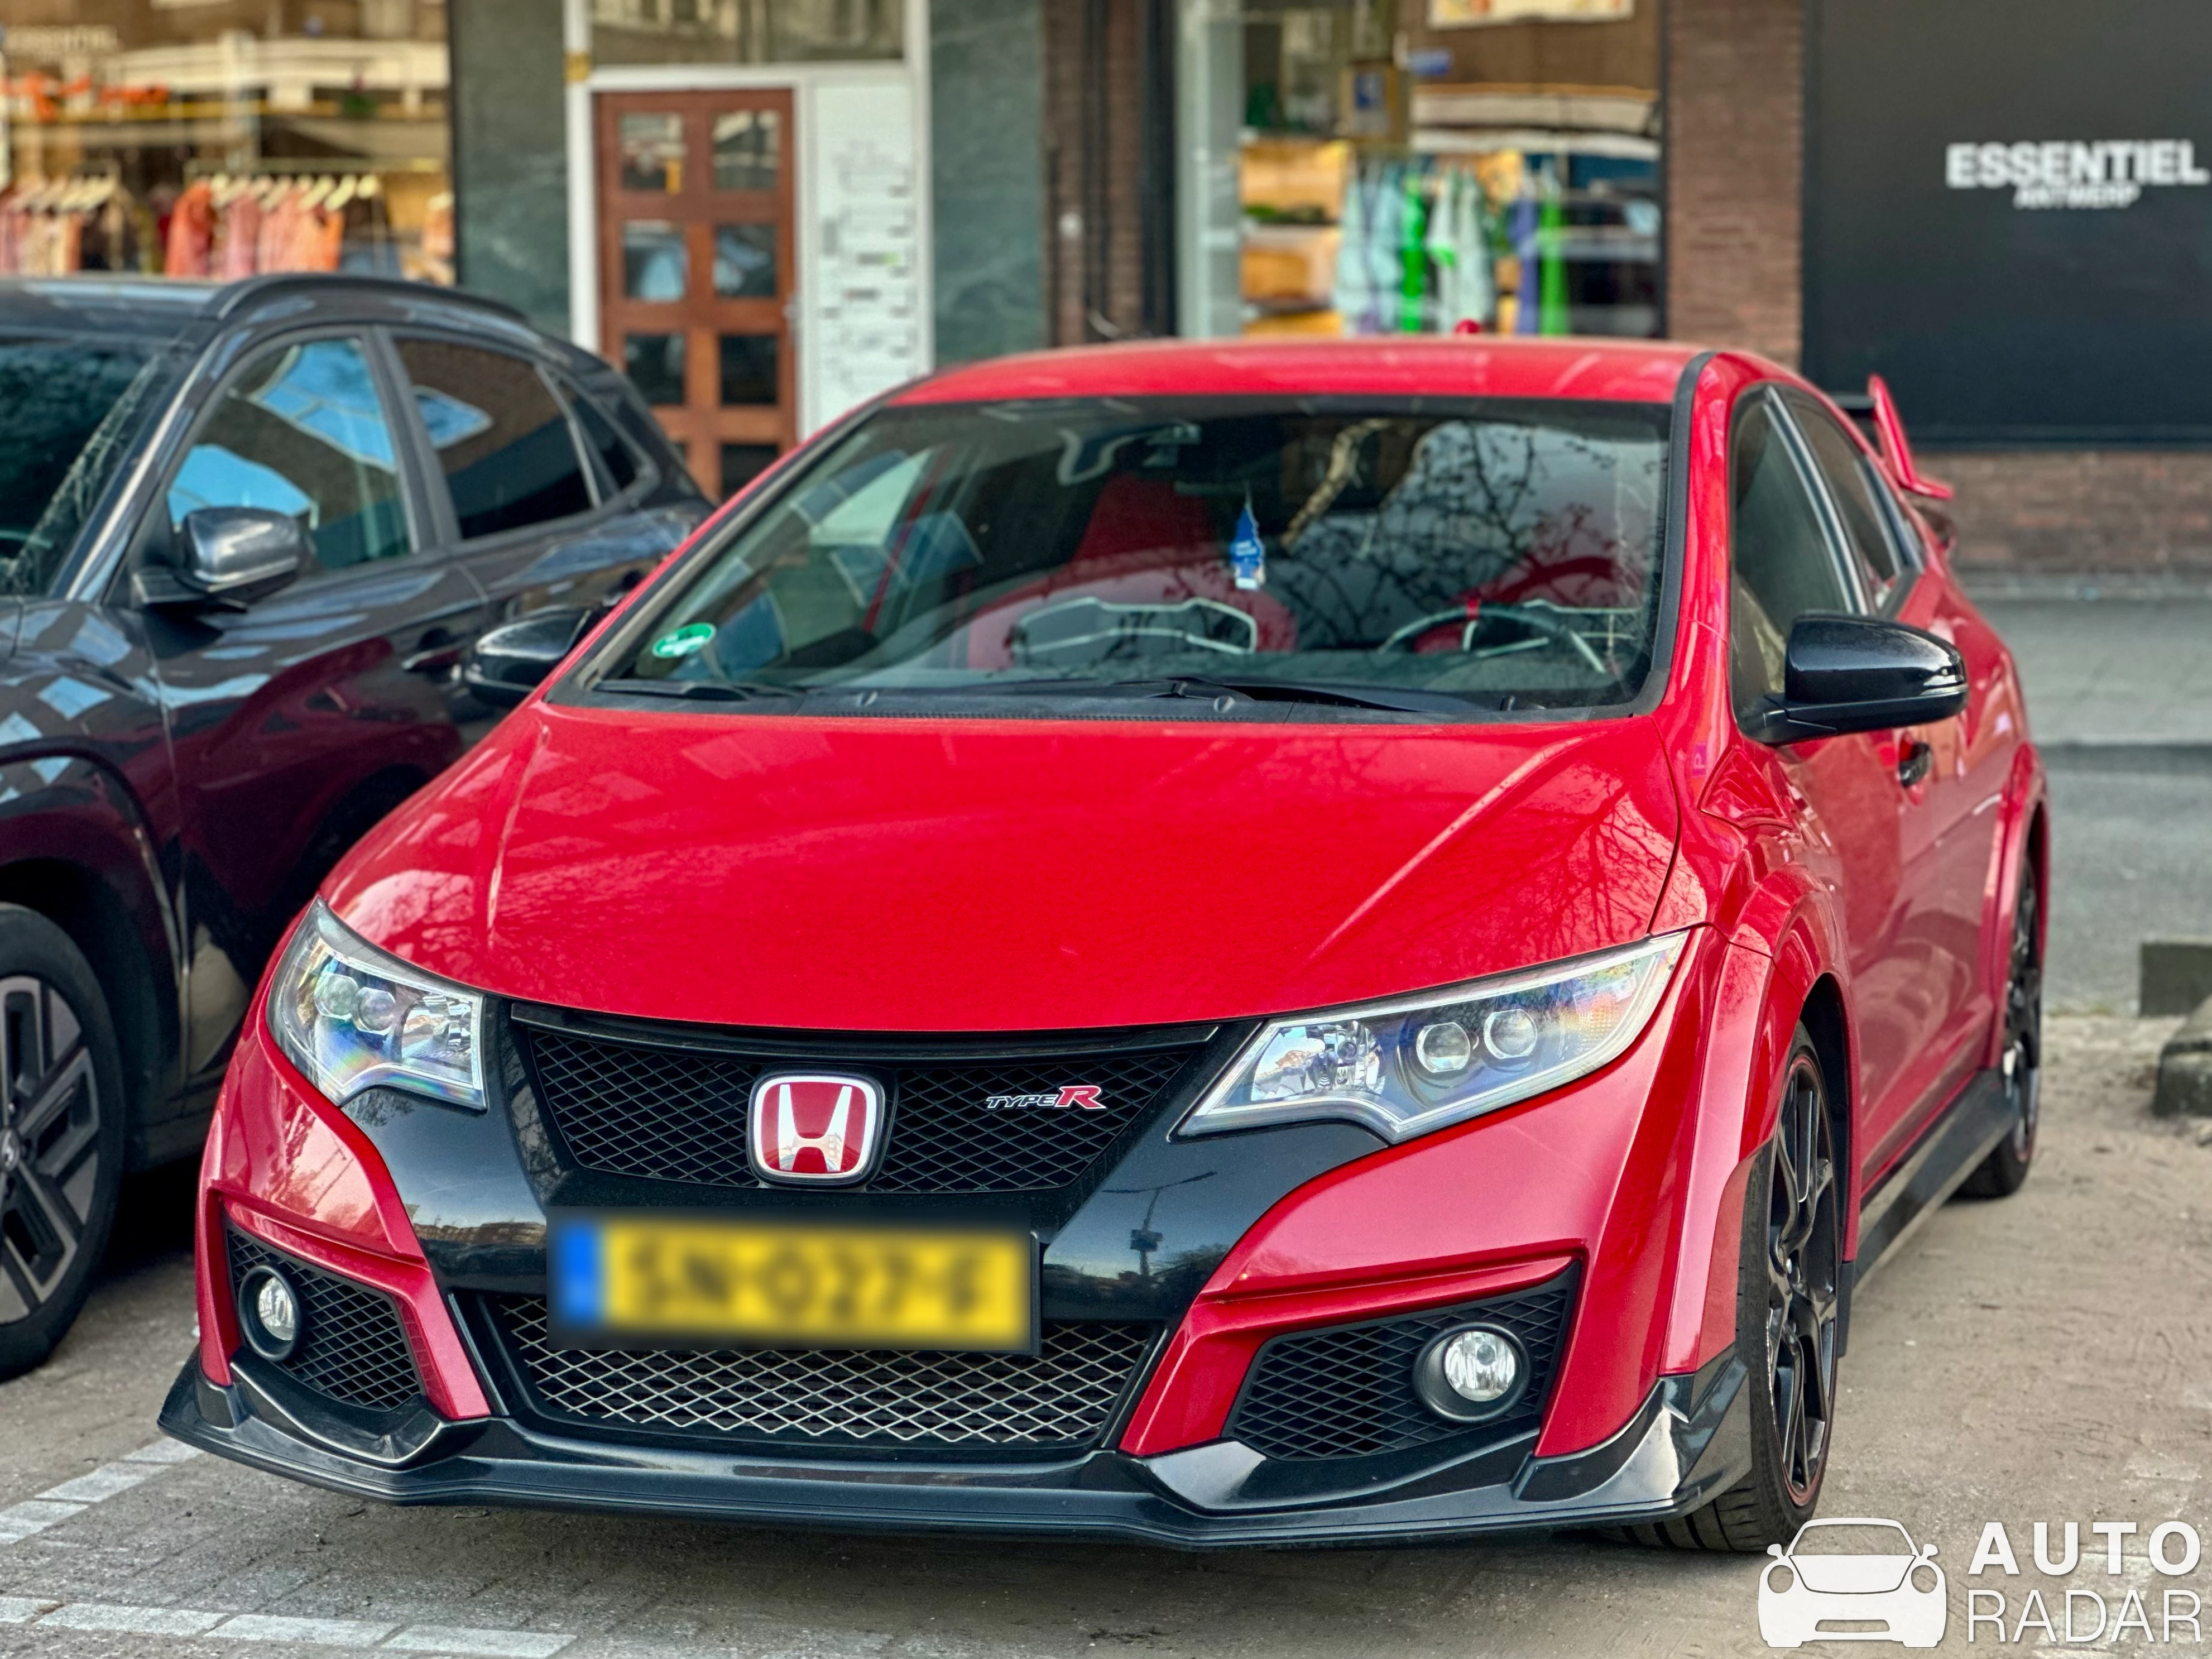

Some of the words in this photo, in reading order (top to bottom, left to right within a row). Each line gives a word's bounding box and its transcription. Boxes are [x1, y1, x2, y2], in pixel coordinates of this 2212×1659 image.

[1946, 138, 2211, 188] ESSENTIEL
[986, 1094, 1059, 1109] TYPE
[1054, 1085, 1106, 1109] R
